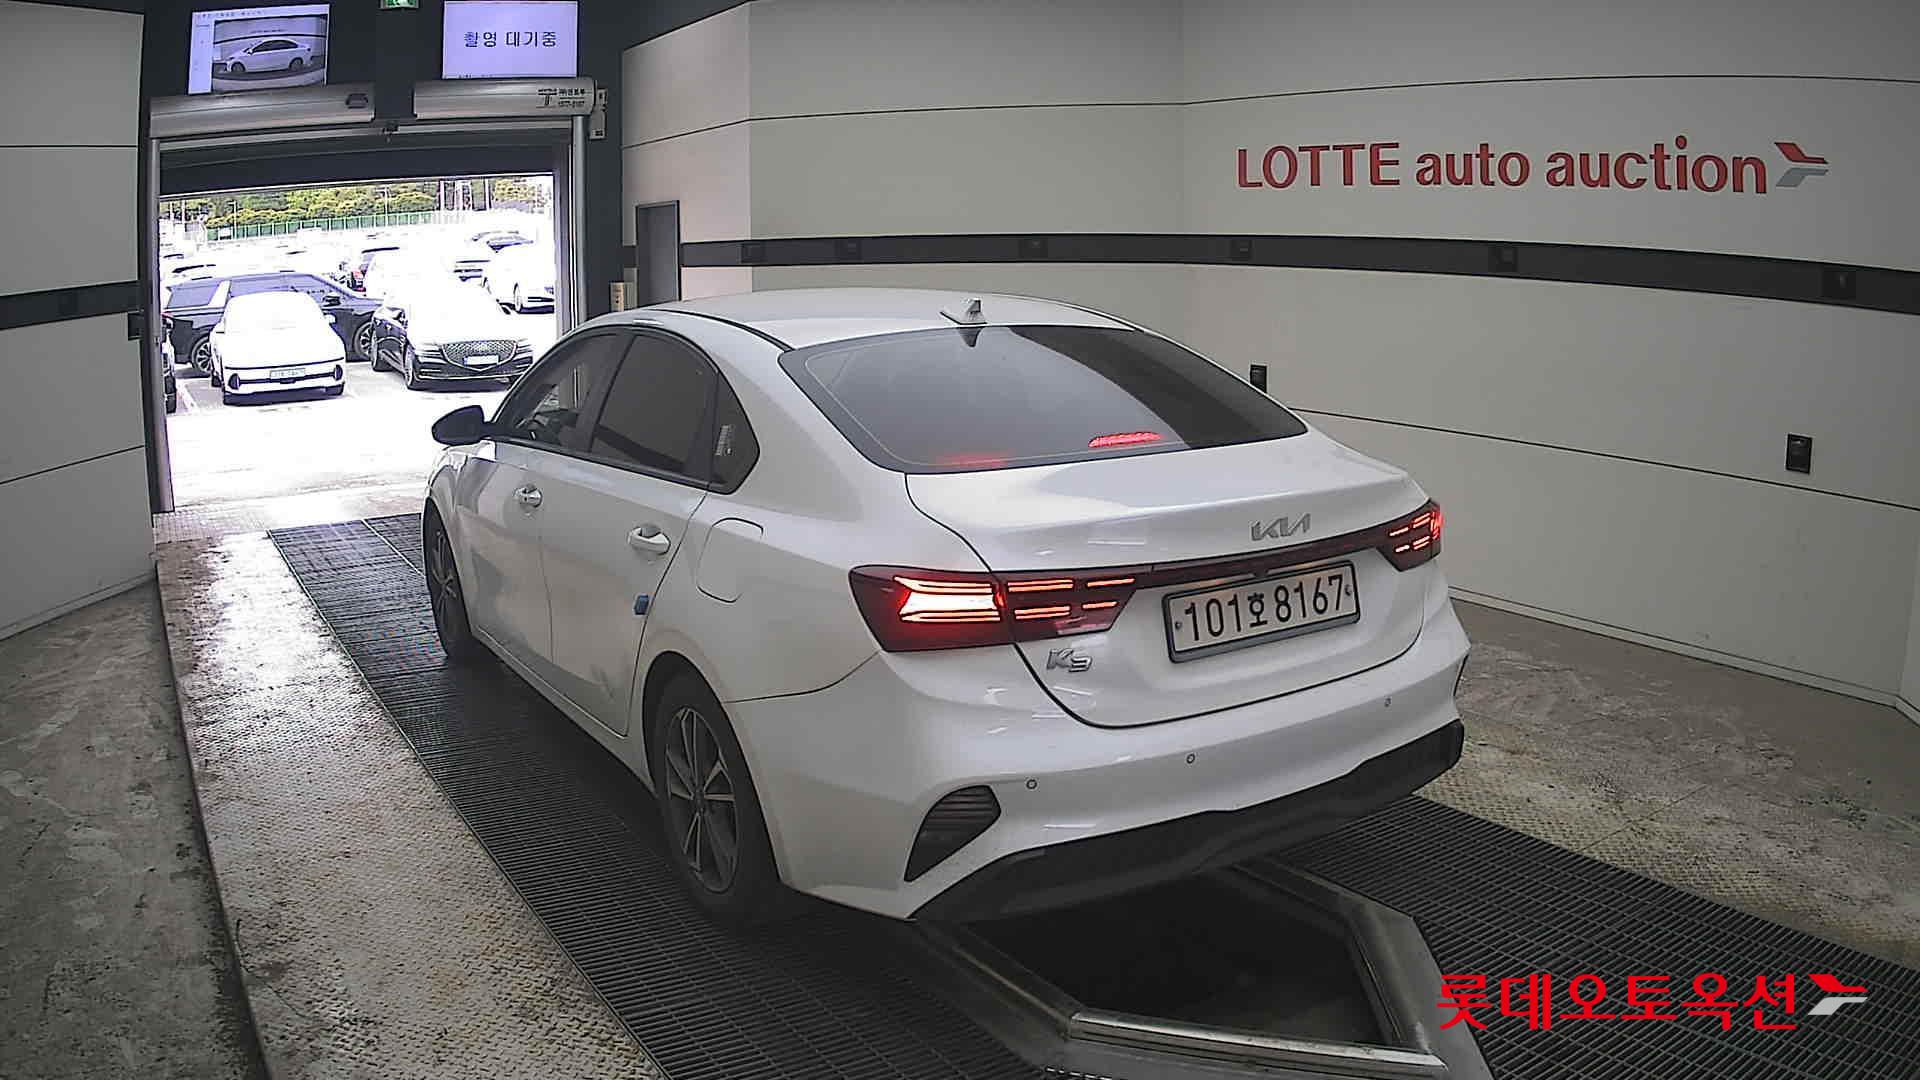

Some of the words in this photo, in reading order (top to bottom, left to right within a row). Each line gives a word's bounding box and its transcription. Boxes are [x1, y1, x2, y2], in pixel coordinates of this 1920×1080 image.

[505, 31, 557, 48] 대기중
[1237, 142, 1400, 188] LOTTE
[1415, 143, 1531, 187] auto
[1545, 136, 1768, 194] auction
[1250, 513, 1311, 541] KIA
[1046, 648, 1093, 673] K3
